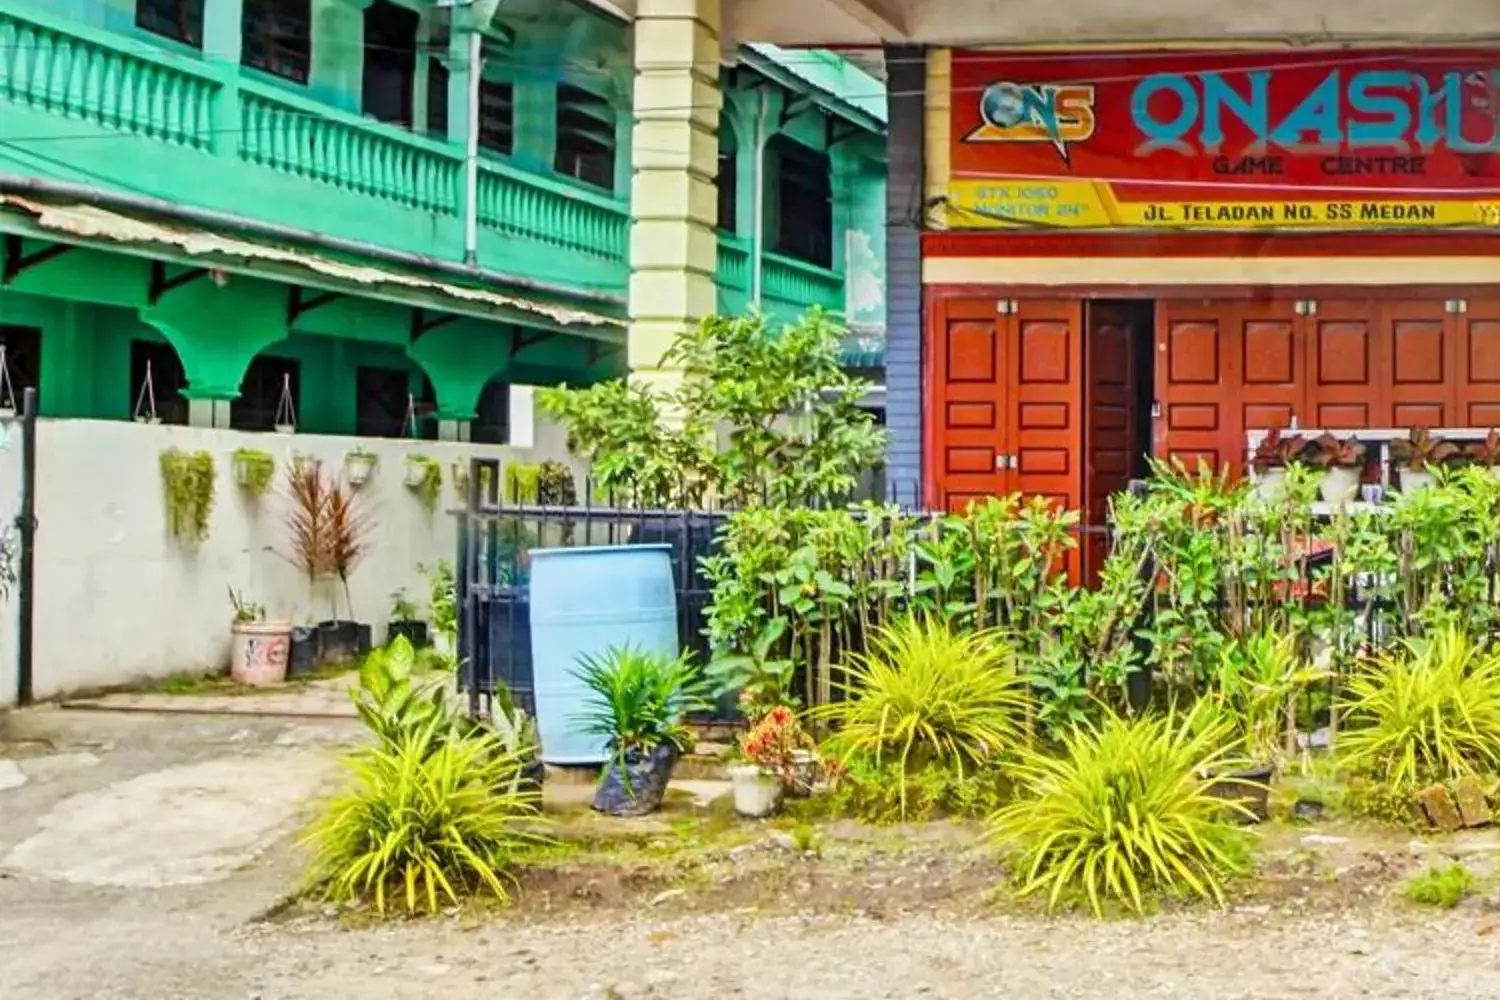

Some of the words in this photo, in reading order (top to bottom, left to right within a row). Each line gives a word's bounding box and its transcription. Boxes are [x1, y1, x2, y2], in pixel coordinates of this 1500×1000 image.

[1213, 156, 1283, 174] GAME
[1320, 156, 1425, 174] CENTRE
[1181, 203, 1274, 220] TELADAN
[1360, 203, 1436, 220] MEDAN
